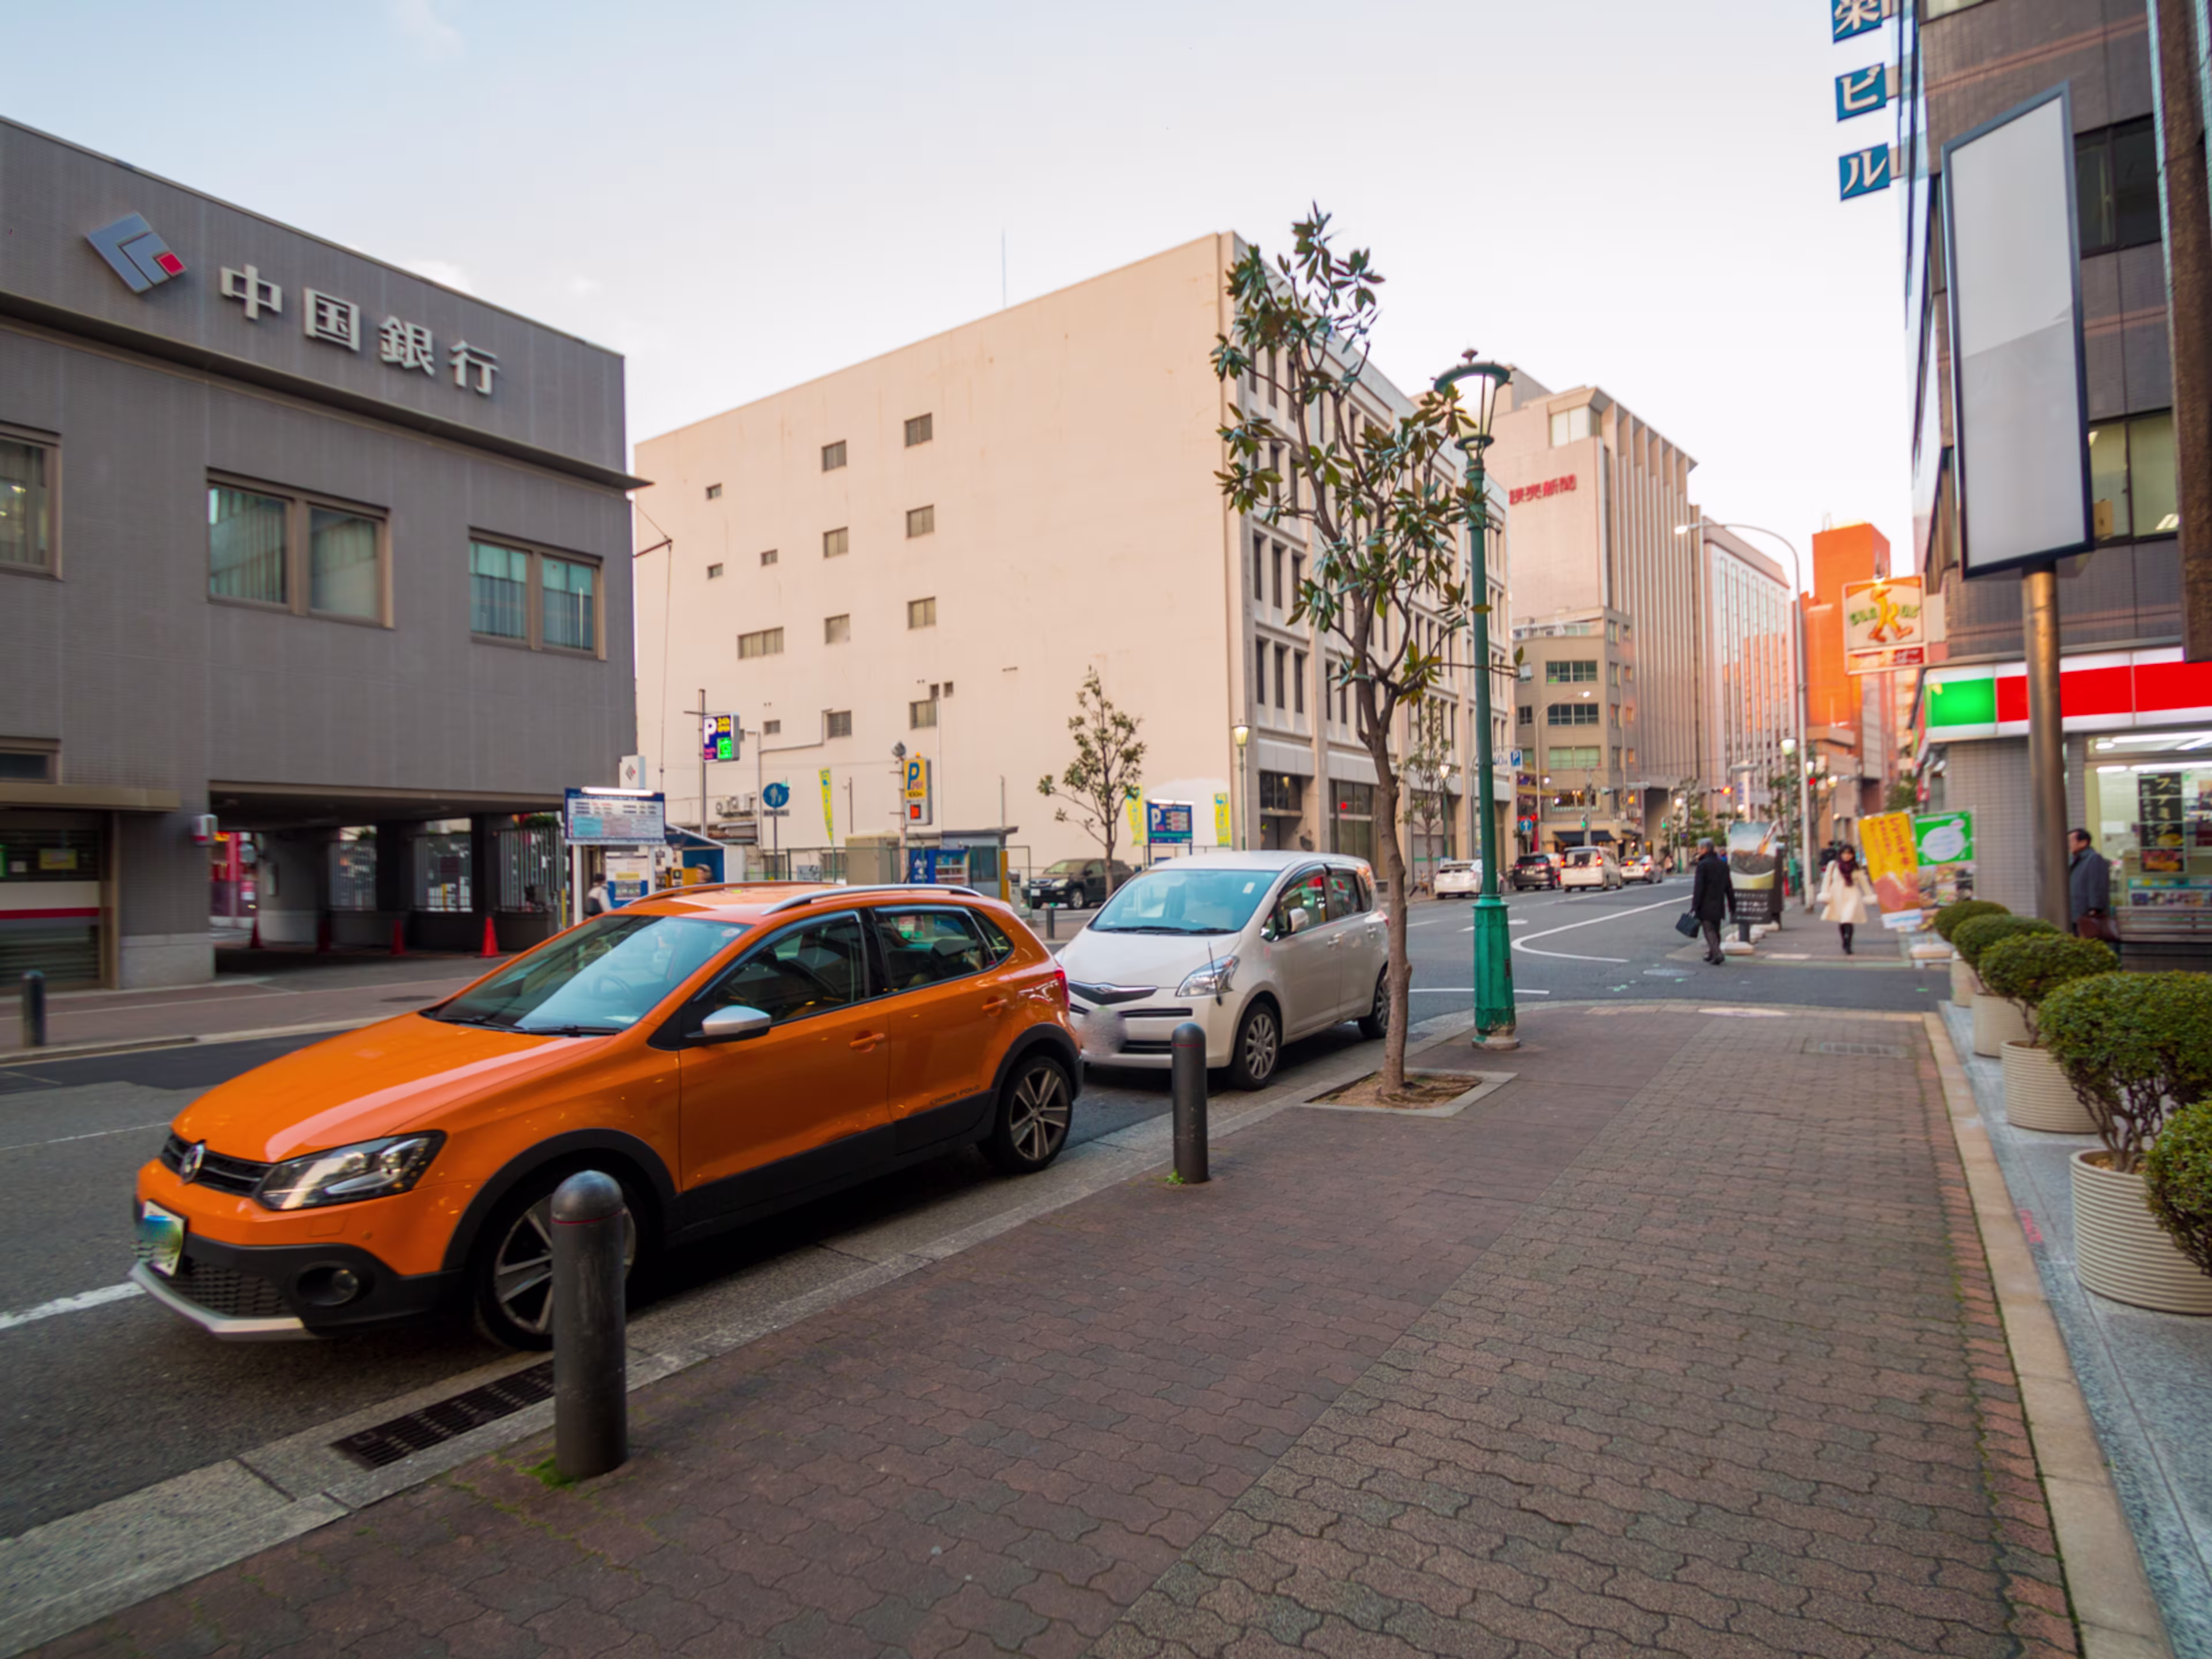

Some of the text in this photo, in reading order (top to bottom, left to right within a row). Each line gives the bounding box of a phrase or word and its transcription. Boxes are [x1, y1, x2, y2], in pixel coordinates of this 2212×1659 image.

[220, 264, 499, 396] 中国銀行
[704, 718, 717, 744] P
[907, 762, 920, 790] P
[1151, 808, 1162, 831] P
